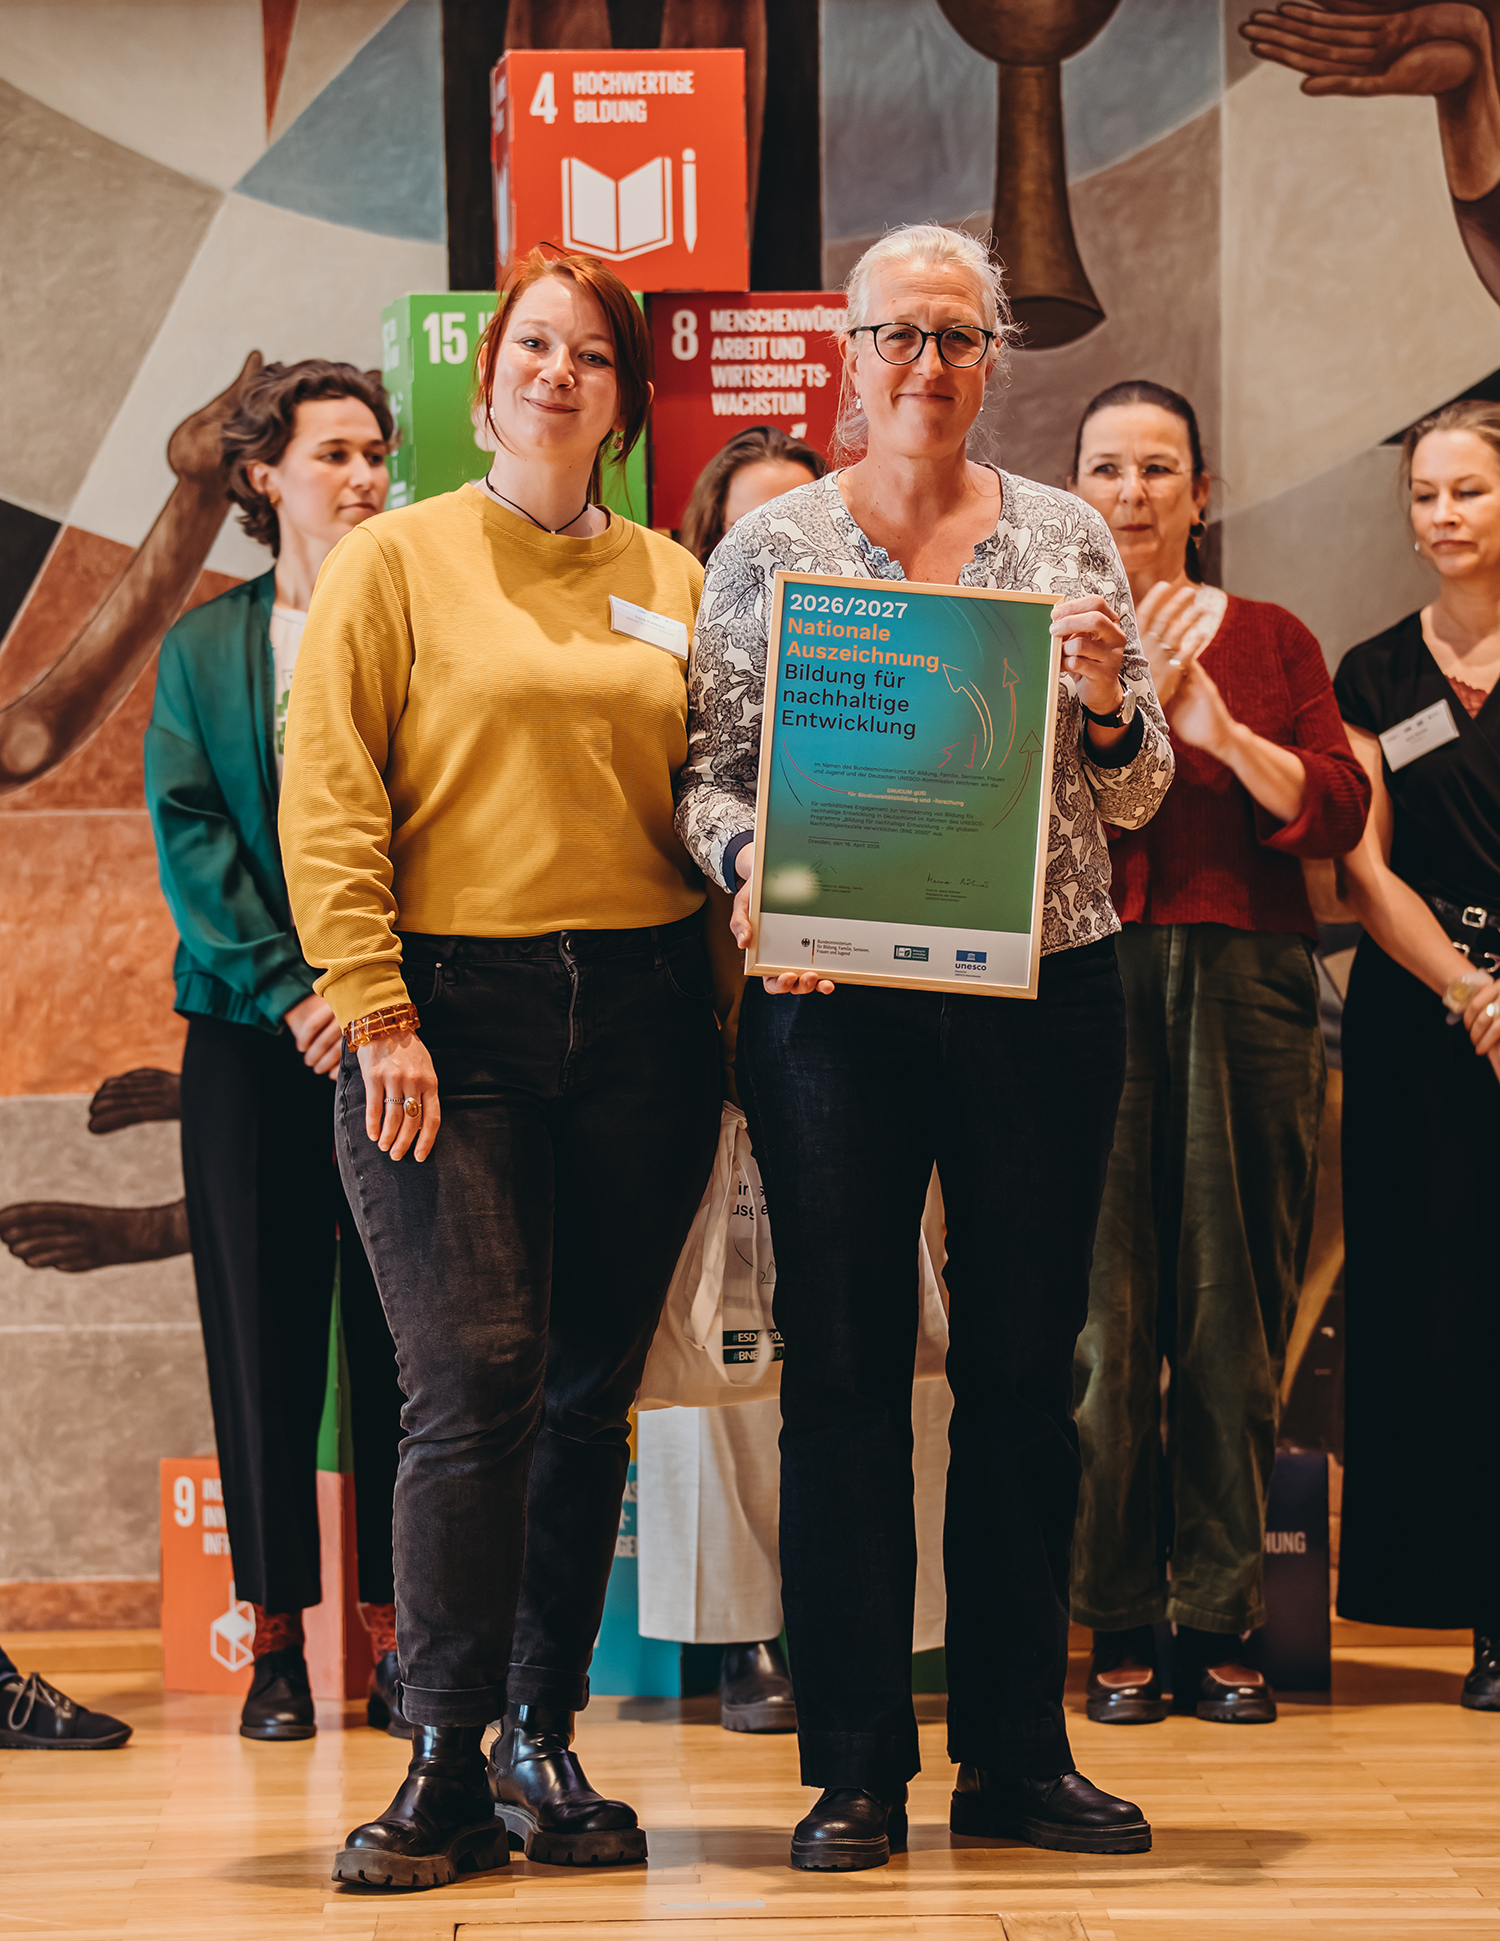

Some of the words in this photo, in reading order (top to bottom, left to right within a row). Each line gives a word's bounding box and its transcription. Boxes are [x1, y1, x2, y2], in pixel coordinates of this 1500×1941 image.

[529, 71, 558, 124] 4
[572, 70, 695, 95] HOCHWERTIGE
[573, 99, 648, 124] BILDUNG
[422, 311, 468, 364] 15
[671, 308, 699, 361] 8
[710, 305, 848, 332] MENSCHENWÜRD
[710, 336, 768, 360] ARBEIT
[769, 336, 806, 360] UND
[710, 363, 831, 388] WIRTSCHAFTS-
[710, 391, 806, 416] WACHSTUM
[790, 593, 908, 619] 2026/2027
[787, 617, 891, 641] Nationale
[786, 640, 940, 673] Auszeichnung
[784, 663, 866, 688] Bildung
[873, 670, 906, 689] für
[782, 688, 910, 715] nachhaltige
[781, 709, 916, 740] Entwicklung
[955, 963, 987, 971] unesco
[173, 1475, 196, 1527] 9
[1265, 1532, 1306, 1554] HUNG
